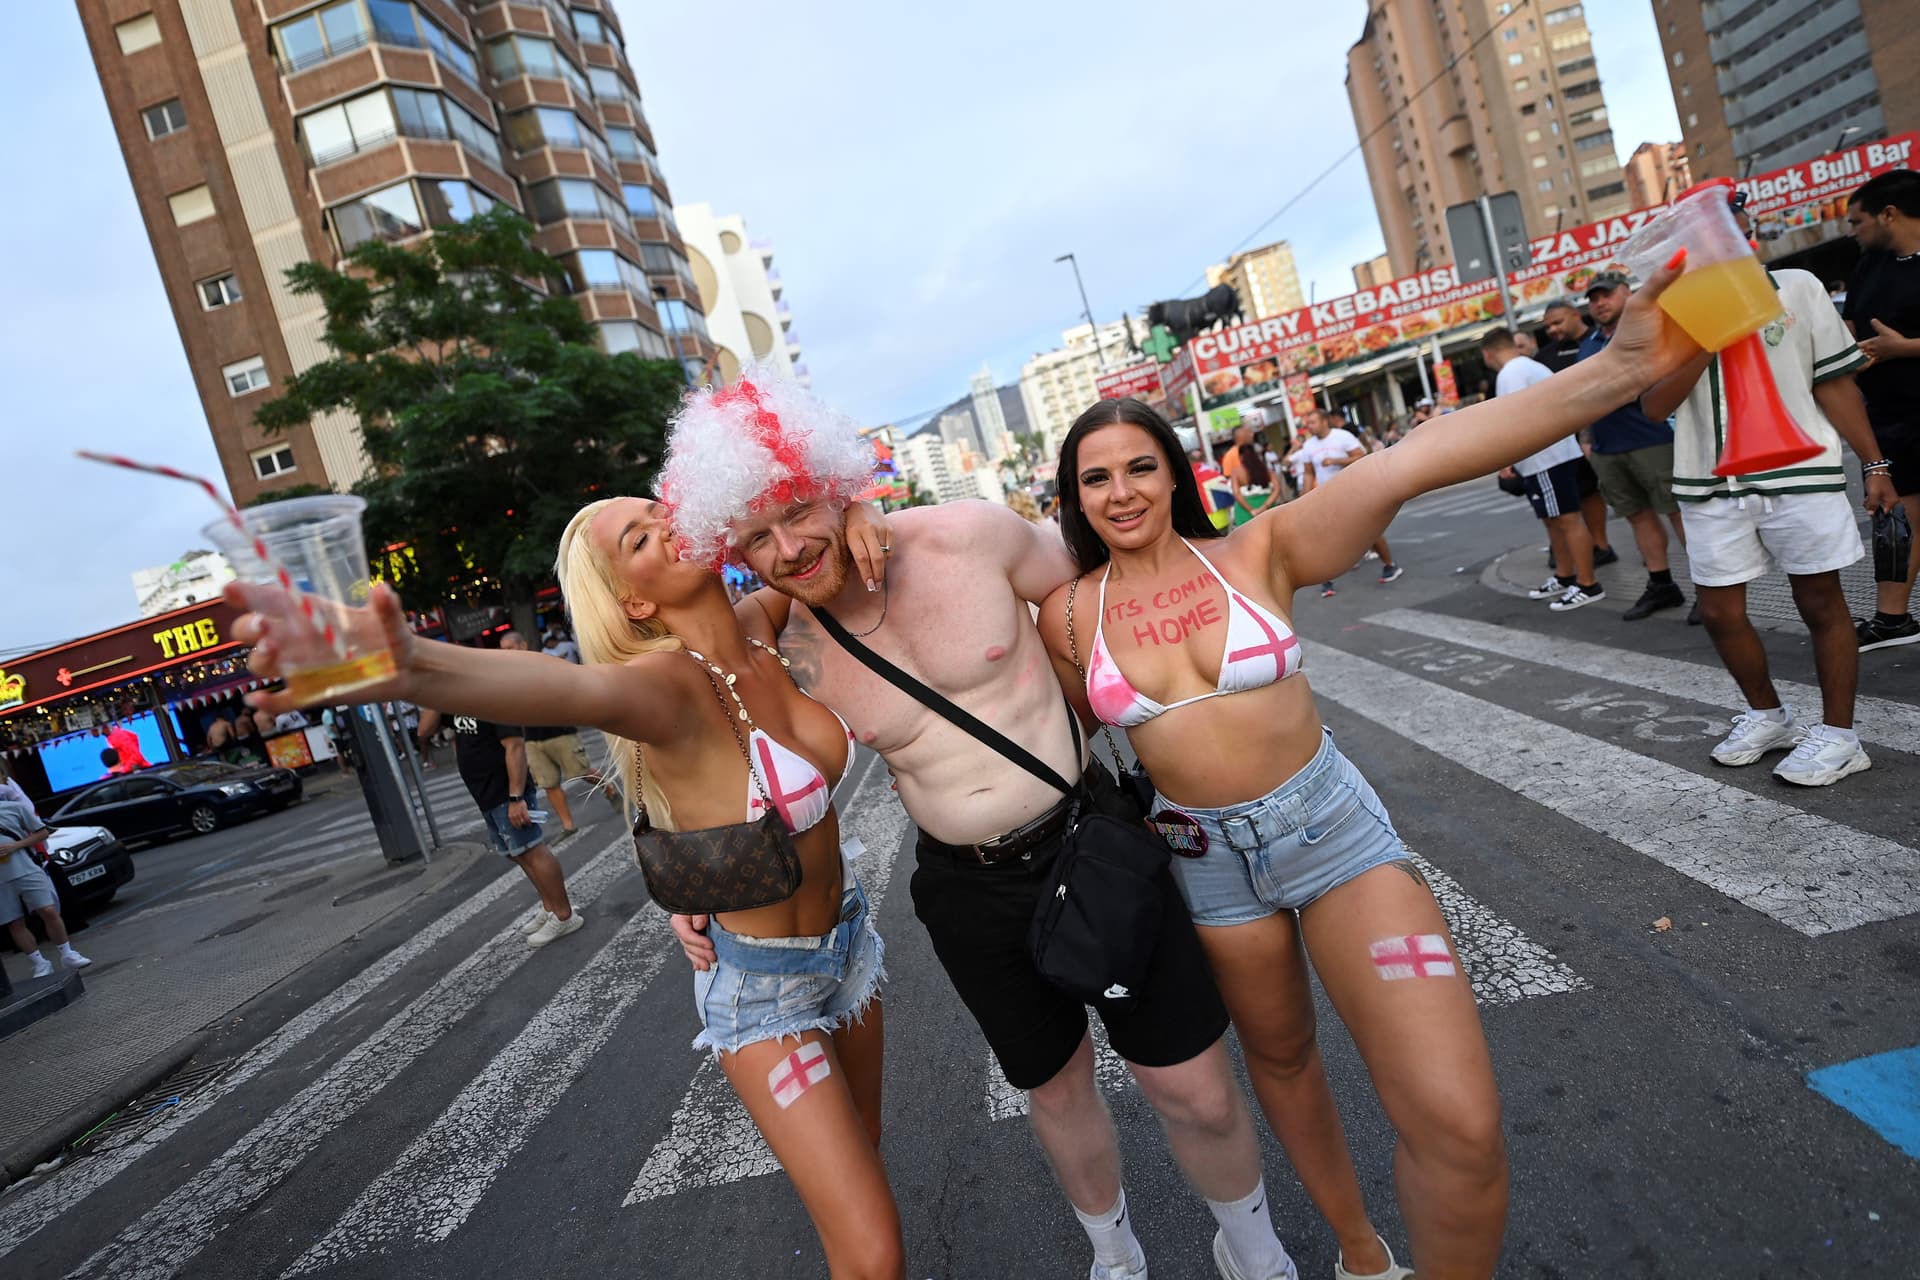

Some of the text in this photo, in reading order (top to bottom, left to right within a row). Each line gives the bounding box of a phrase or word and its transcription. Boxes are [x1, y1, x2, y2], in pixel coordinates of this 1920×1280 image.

[1736, 140, 1912, 204] Black Bull Bar
[1790, 171, 1872, 200] Breakfast
[1195, 311, 1300, 360] CURRY
[1229, 347, 1256, 364] EAT
[1260, 344, 1273, 354] &
[1276, 331, 1312, 350] TAKE
[1316, 320, 1356, 340] AWAY
[1391, 277, 1499, 317] RESTAURANTE
[1515, 263, 1548, 282] BAR
[1105, 598, 1144, 625] ITS
[1132, 598, 1222, 648] HOME
[153, 618, 219, 659] THE
[1166, 834, 1201, 851] GIRL
